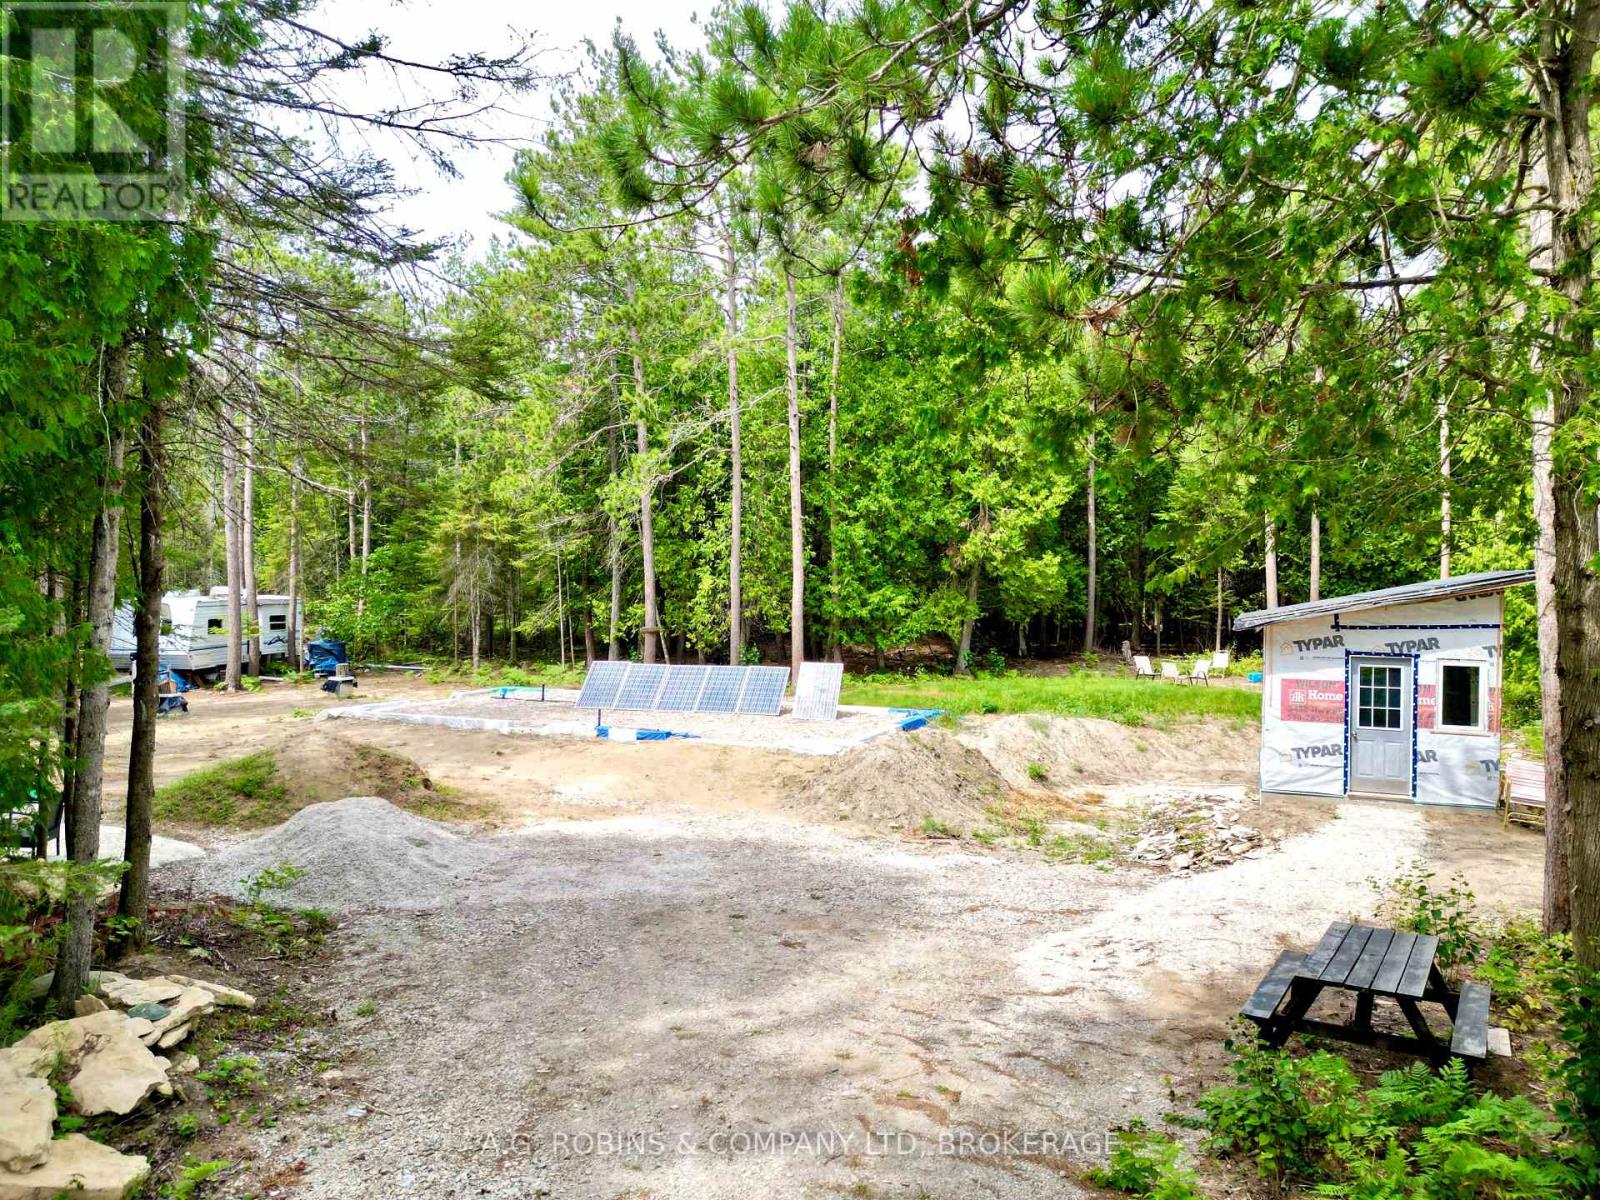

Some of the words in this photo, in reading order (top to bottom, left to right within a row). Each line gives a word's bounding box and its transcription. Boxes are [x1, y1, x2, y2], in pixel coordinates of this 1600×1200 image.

[1292, 635, 1345, 652] TYPAR
[1385, 637, 1440, 655] TYPAR
[1308, 689, 1344, 701] Home
[1291, 744, 1344, 760] TYPAR
